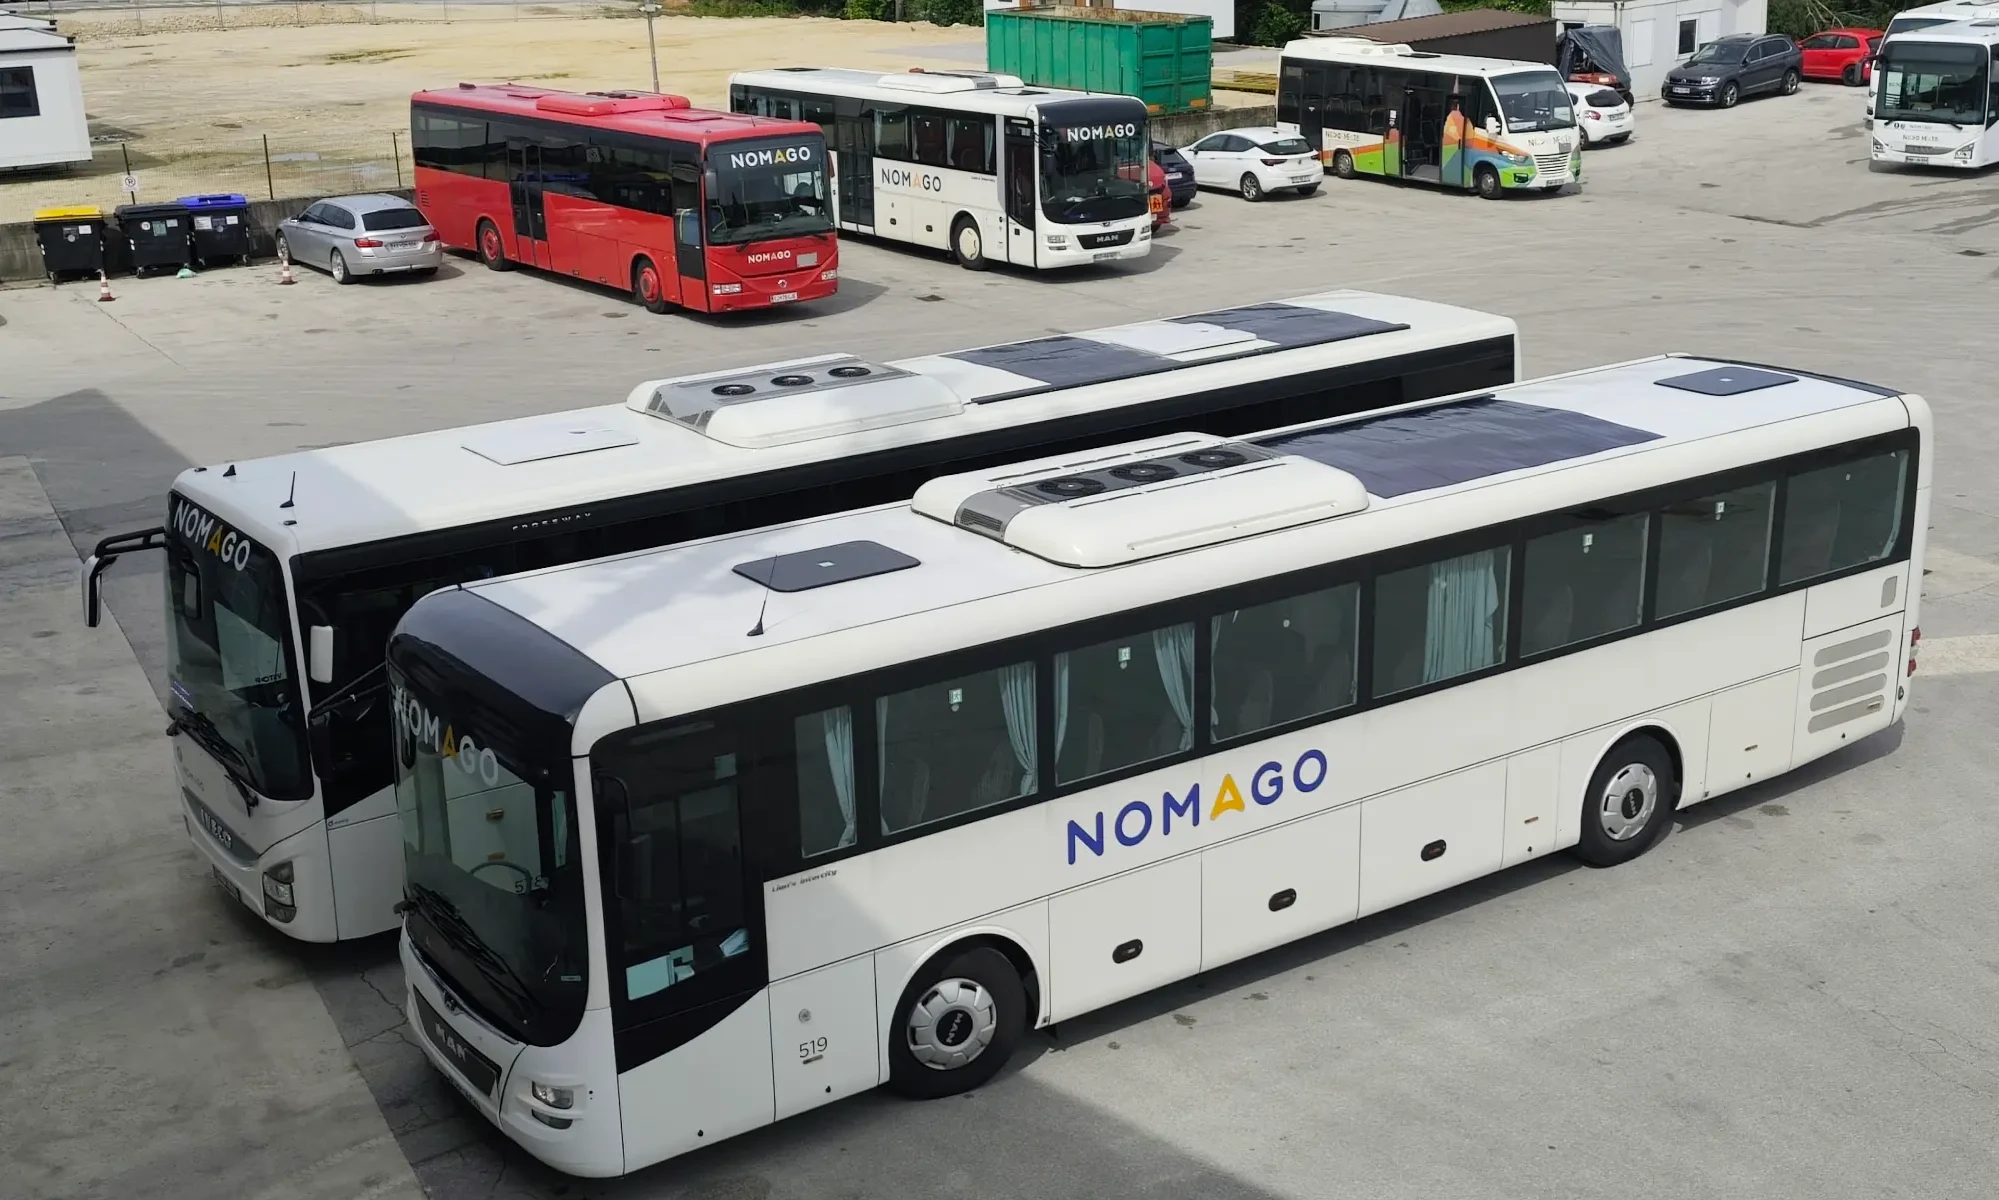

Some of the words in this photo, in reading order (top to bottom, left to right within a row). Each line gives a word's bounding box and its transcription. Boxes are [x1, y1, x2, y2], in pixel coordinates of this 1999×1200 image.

[1066, 123, 1136, 142] NOMAGO
[731, 146, 811, 169] NOMAGO
[881, 167, 942, 192] NOMAGO
[1096, 234, 1119, 243] MAN
[747, 250, 791, 264] NOMAGO
[173, 499, 251, 571] NOMAGO
[393, 684, 499, 787] NOMAGO
[1067, 748, 1328, 866] NOMAGO
[946, 1012, 964, 1043] MAN
[435, 1022, 466, 1063] MAN
[799, 1036, 828, 1059] 519
